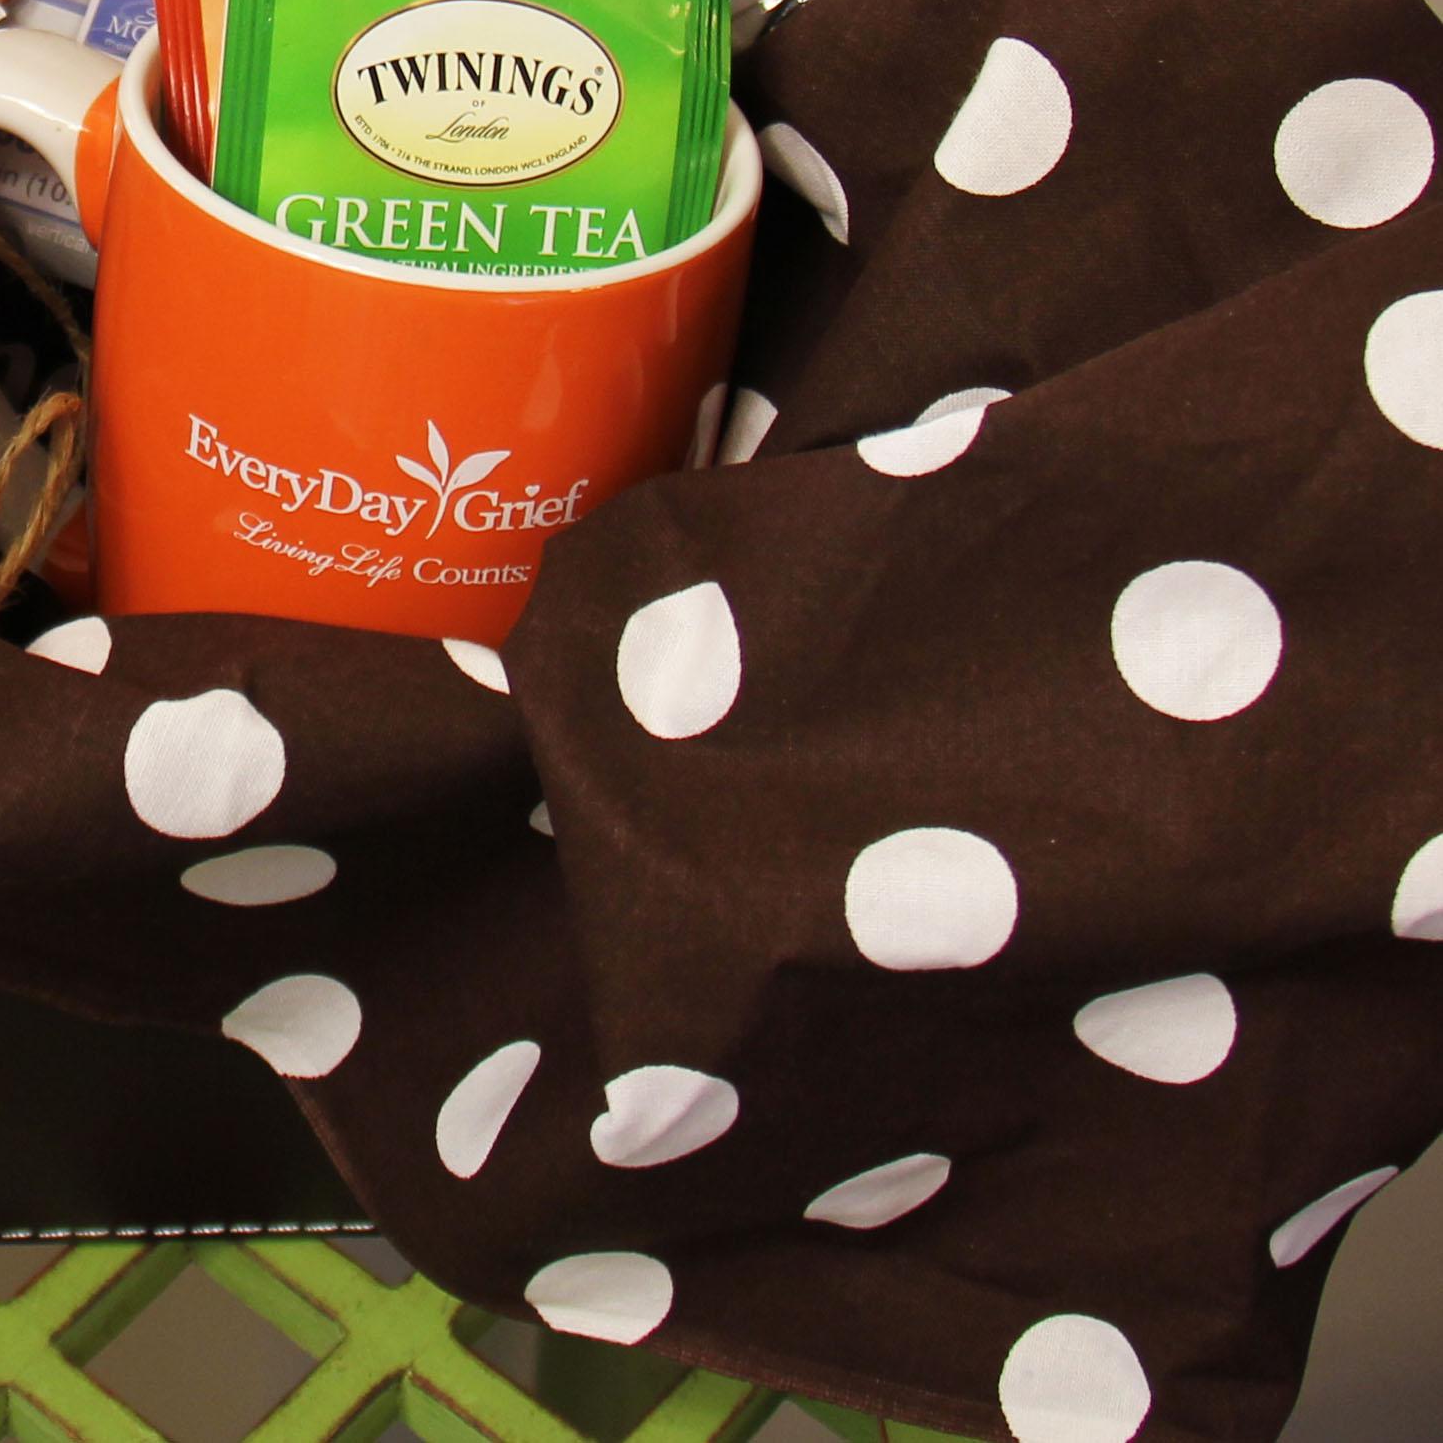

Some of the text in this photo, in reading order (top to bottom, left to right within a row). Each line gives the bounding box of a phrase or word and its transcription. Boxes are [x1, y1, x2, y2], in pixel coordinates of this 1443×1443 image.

[425, 111, 510, 144] London
[471, 99, 486, 108] OF
[414, 156, 431, 168] THE
[475, 164, 518, 176] LONDON
[546, 134, 588, 163] ENGLAND
[275, 193, 648, 259] GREEN TEA
[184, 414, 589, 537] EveryDay Grief
[233, 511, 335, 577] Living
[334, 543, 404, 587] Life
